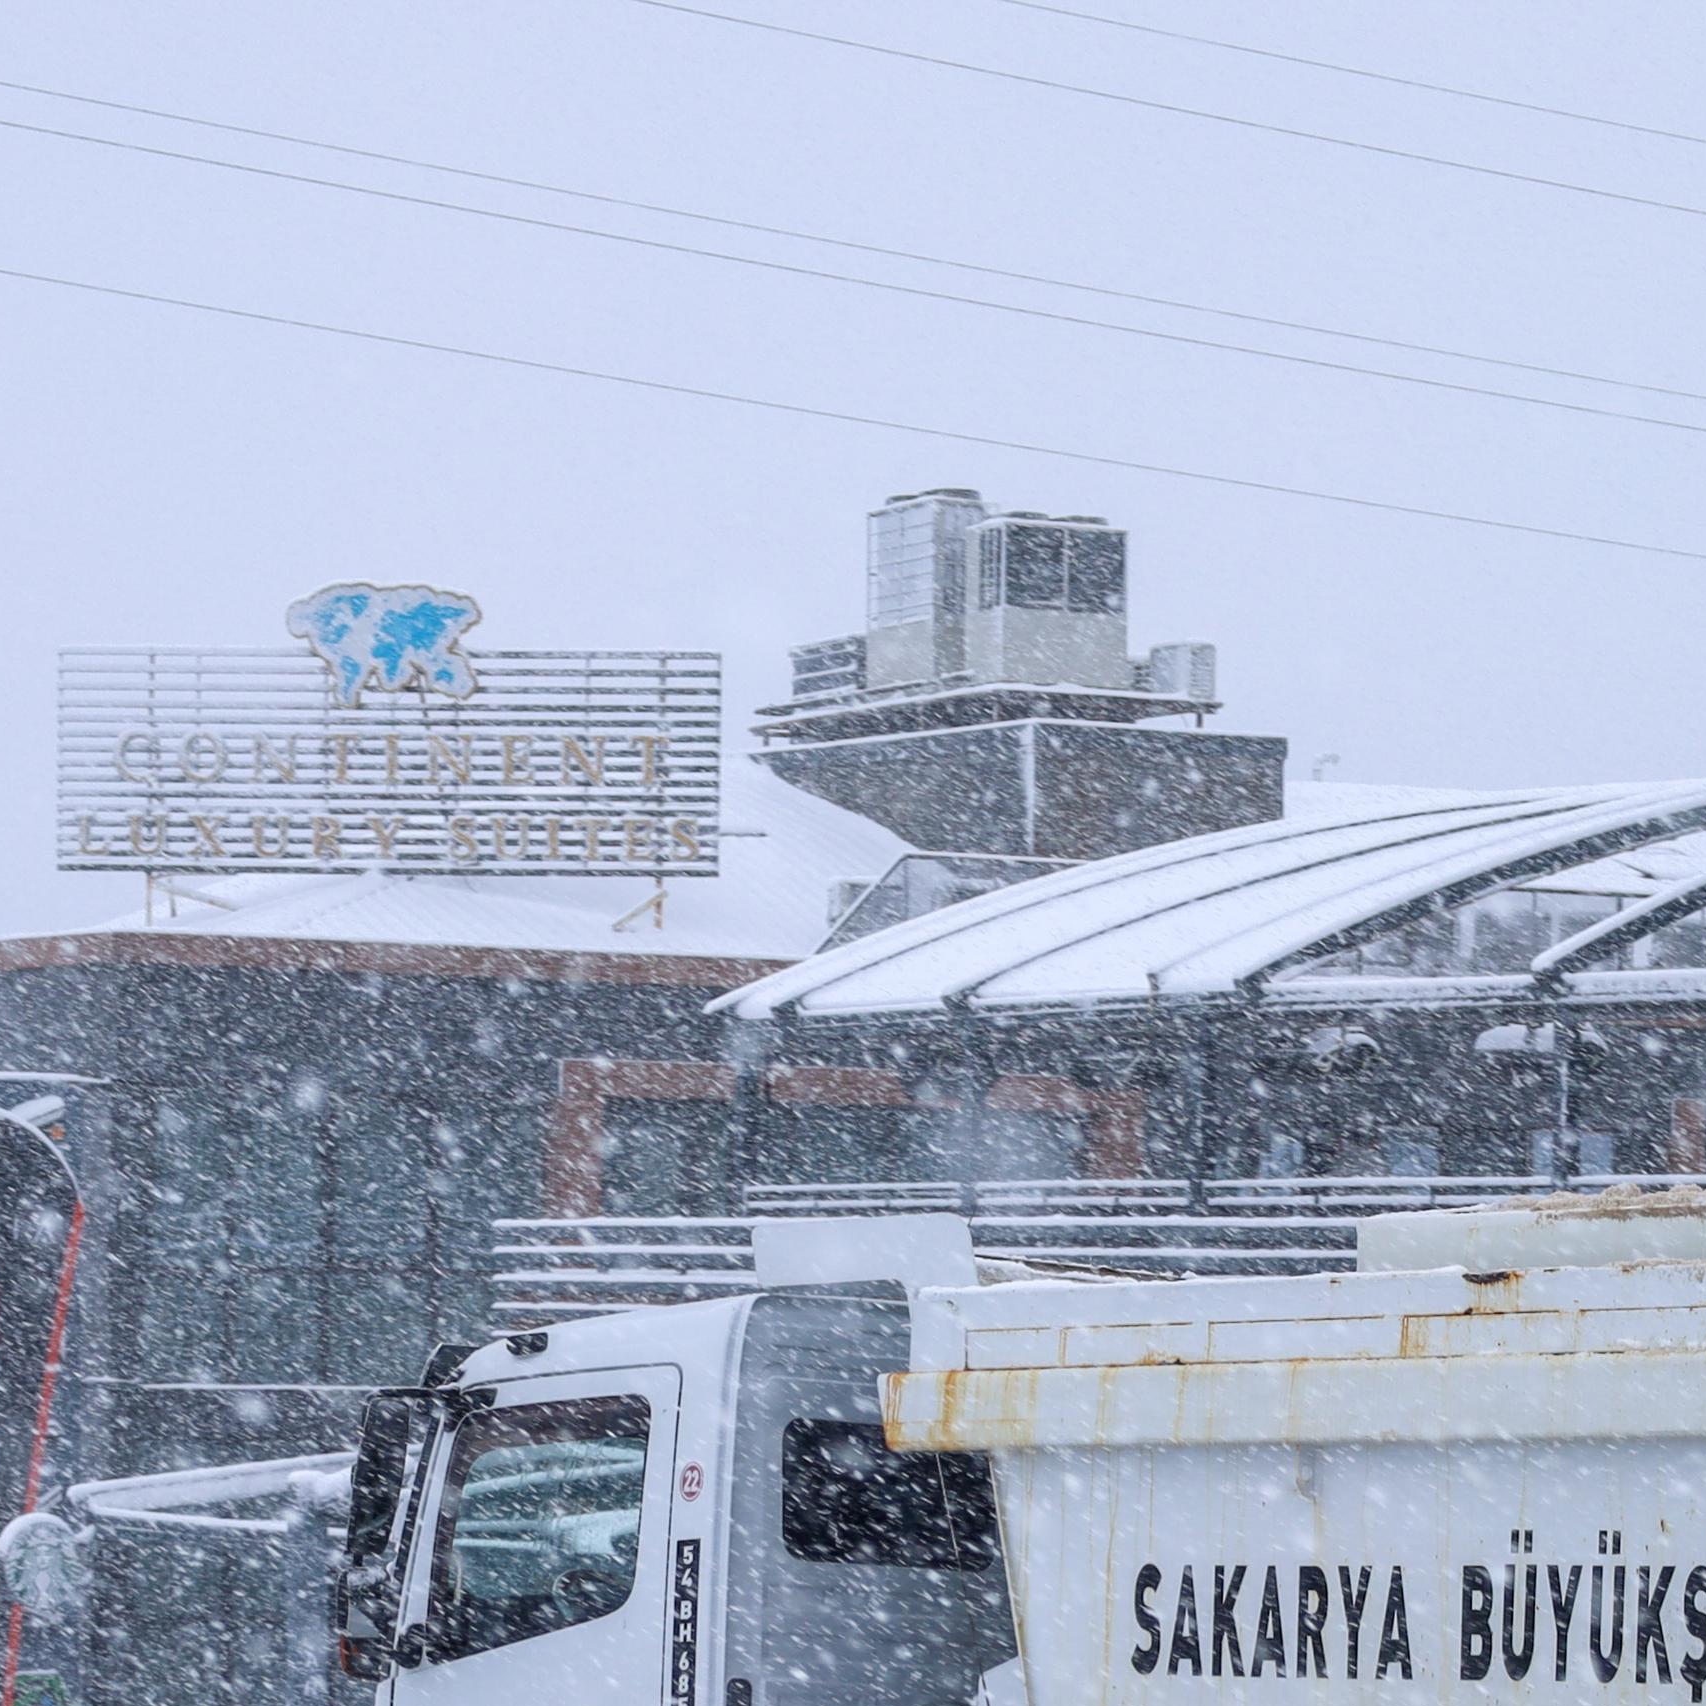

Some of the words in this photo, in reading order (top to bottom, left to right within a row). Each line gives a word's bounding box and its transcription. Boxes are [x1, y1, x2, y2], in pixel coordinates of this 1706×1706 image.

[113, 731, 670, 788] CONTINENT
[74, 809, 407, 860] LUXURY
[444, 811, 701, 864] SUITES
[683, 1469, 700, 1491] 22
[1130, 1563, 1413, 1680] SAKARYA
